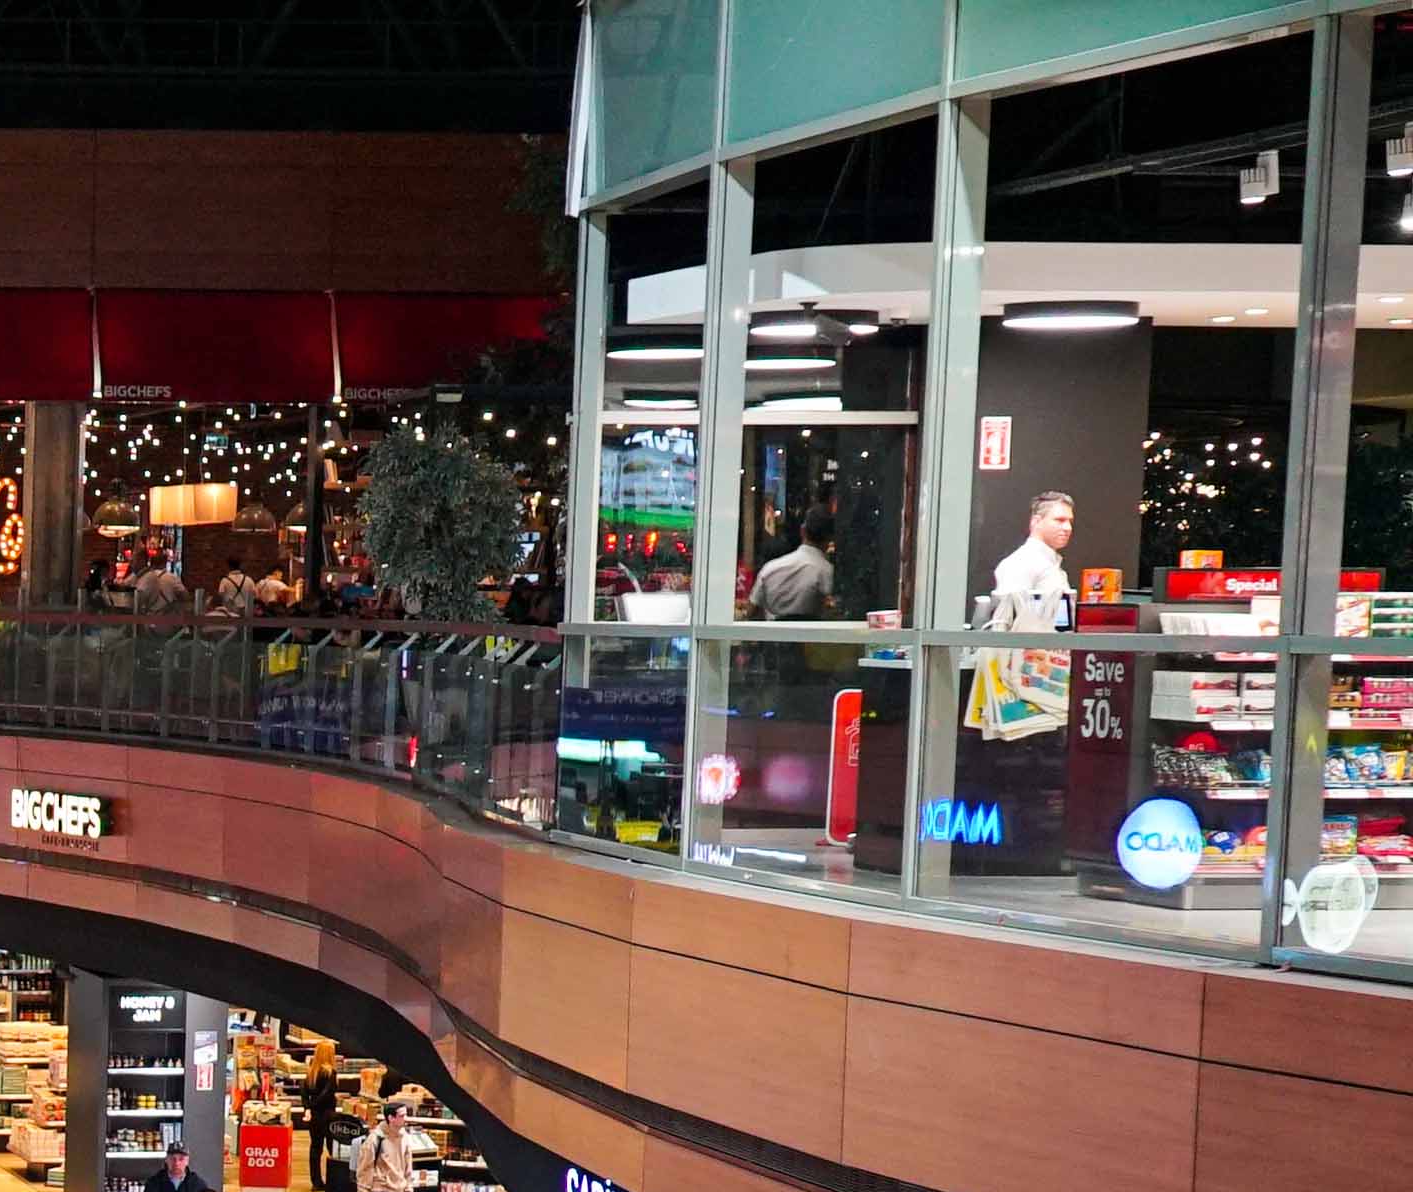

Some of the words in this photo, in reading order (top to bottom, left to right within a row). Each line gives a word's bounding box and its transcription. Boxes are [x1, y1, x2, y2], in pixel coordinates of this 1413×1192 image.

[104, 384, 172, 398] BIGCHEFS
[1225, 577, 1278, 592] Special
[1084, 653, 1125, 682] Save
[1080, 699, 1124, 740] 30%
[11, 788, 101, 840] BIGCHEFS
[245, 1147, 279, 1158] GRAB
